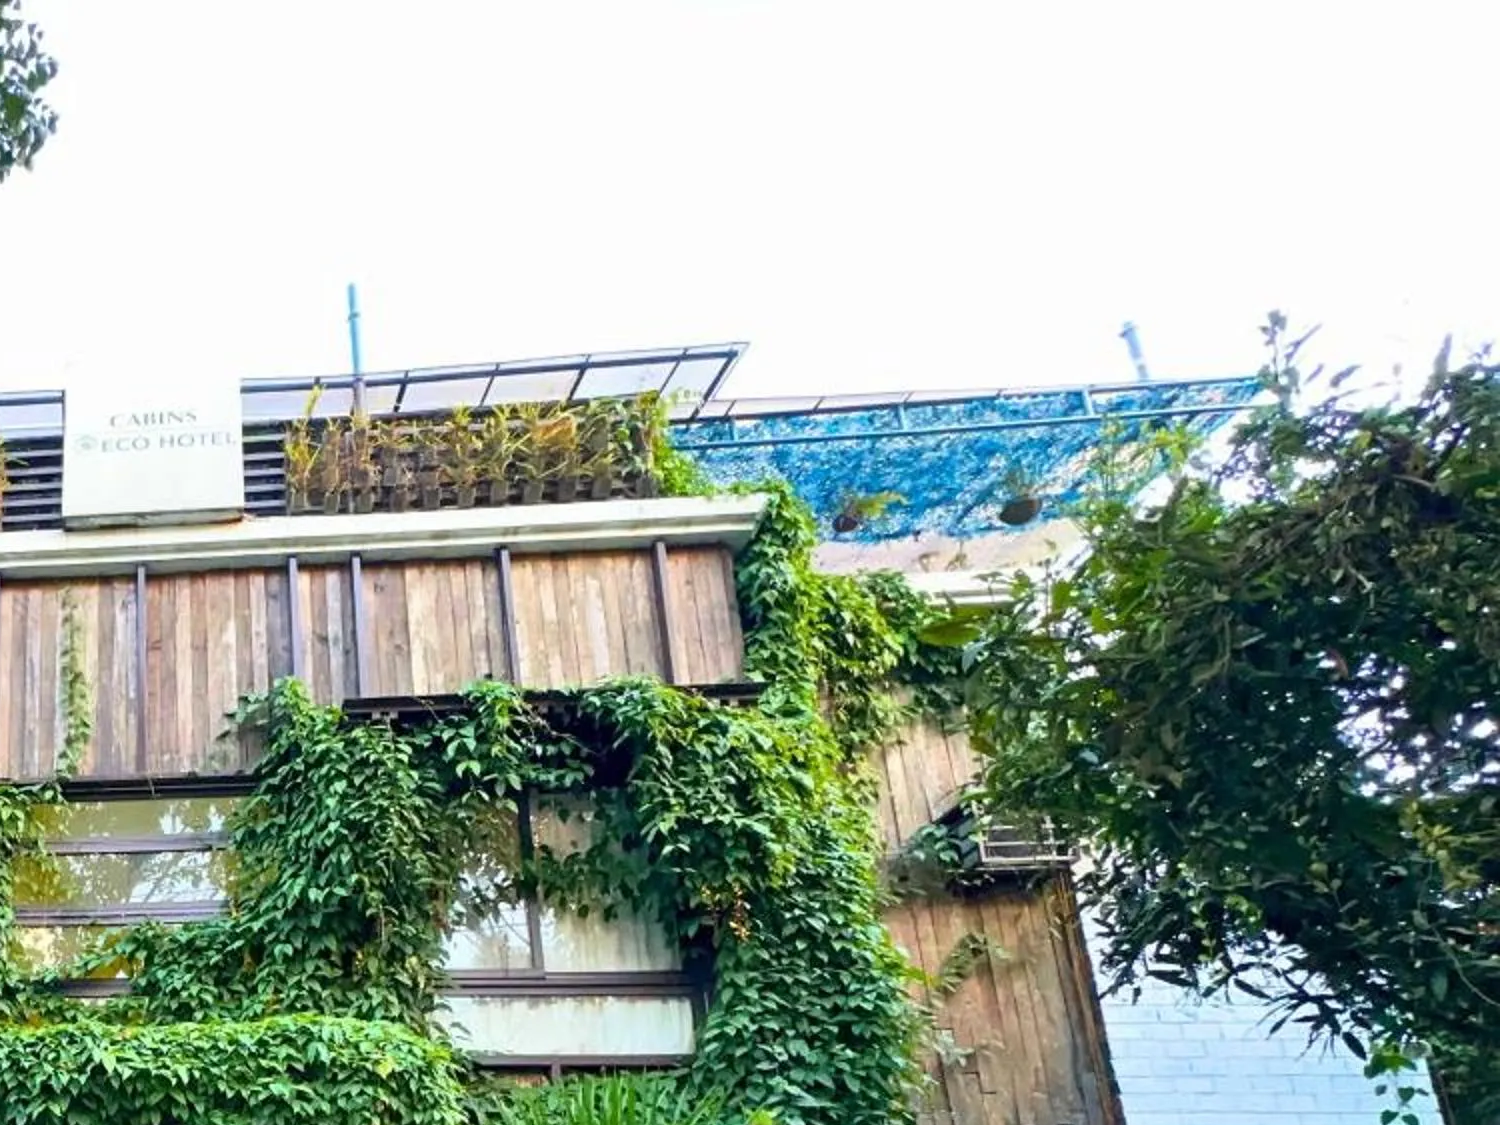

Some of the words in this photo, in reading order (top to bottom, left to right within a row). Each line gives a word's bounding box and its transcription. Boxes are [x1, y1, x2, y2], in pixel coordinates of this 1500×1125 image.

[109, 410, 197, 428] CABINS
[101, 434, 151, 453] ECO
[159, 431, 237, 449] HOTEL
